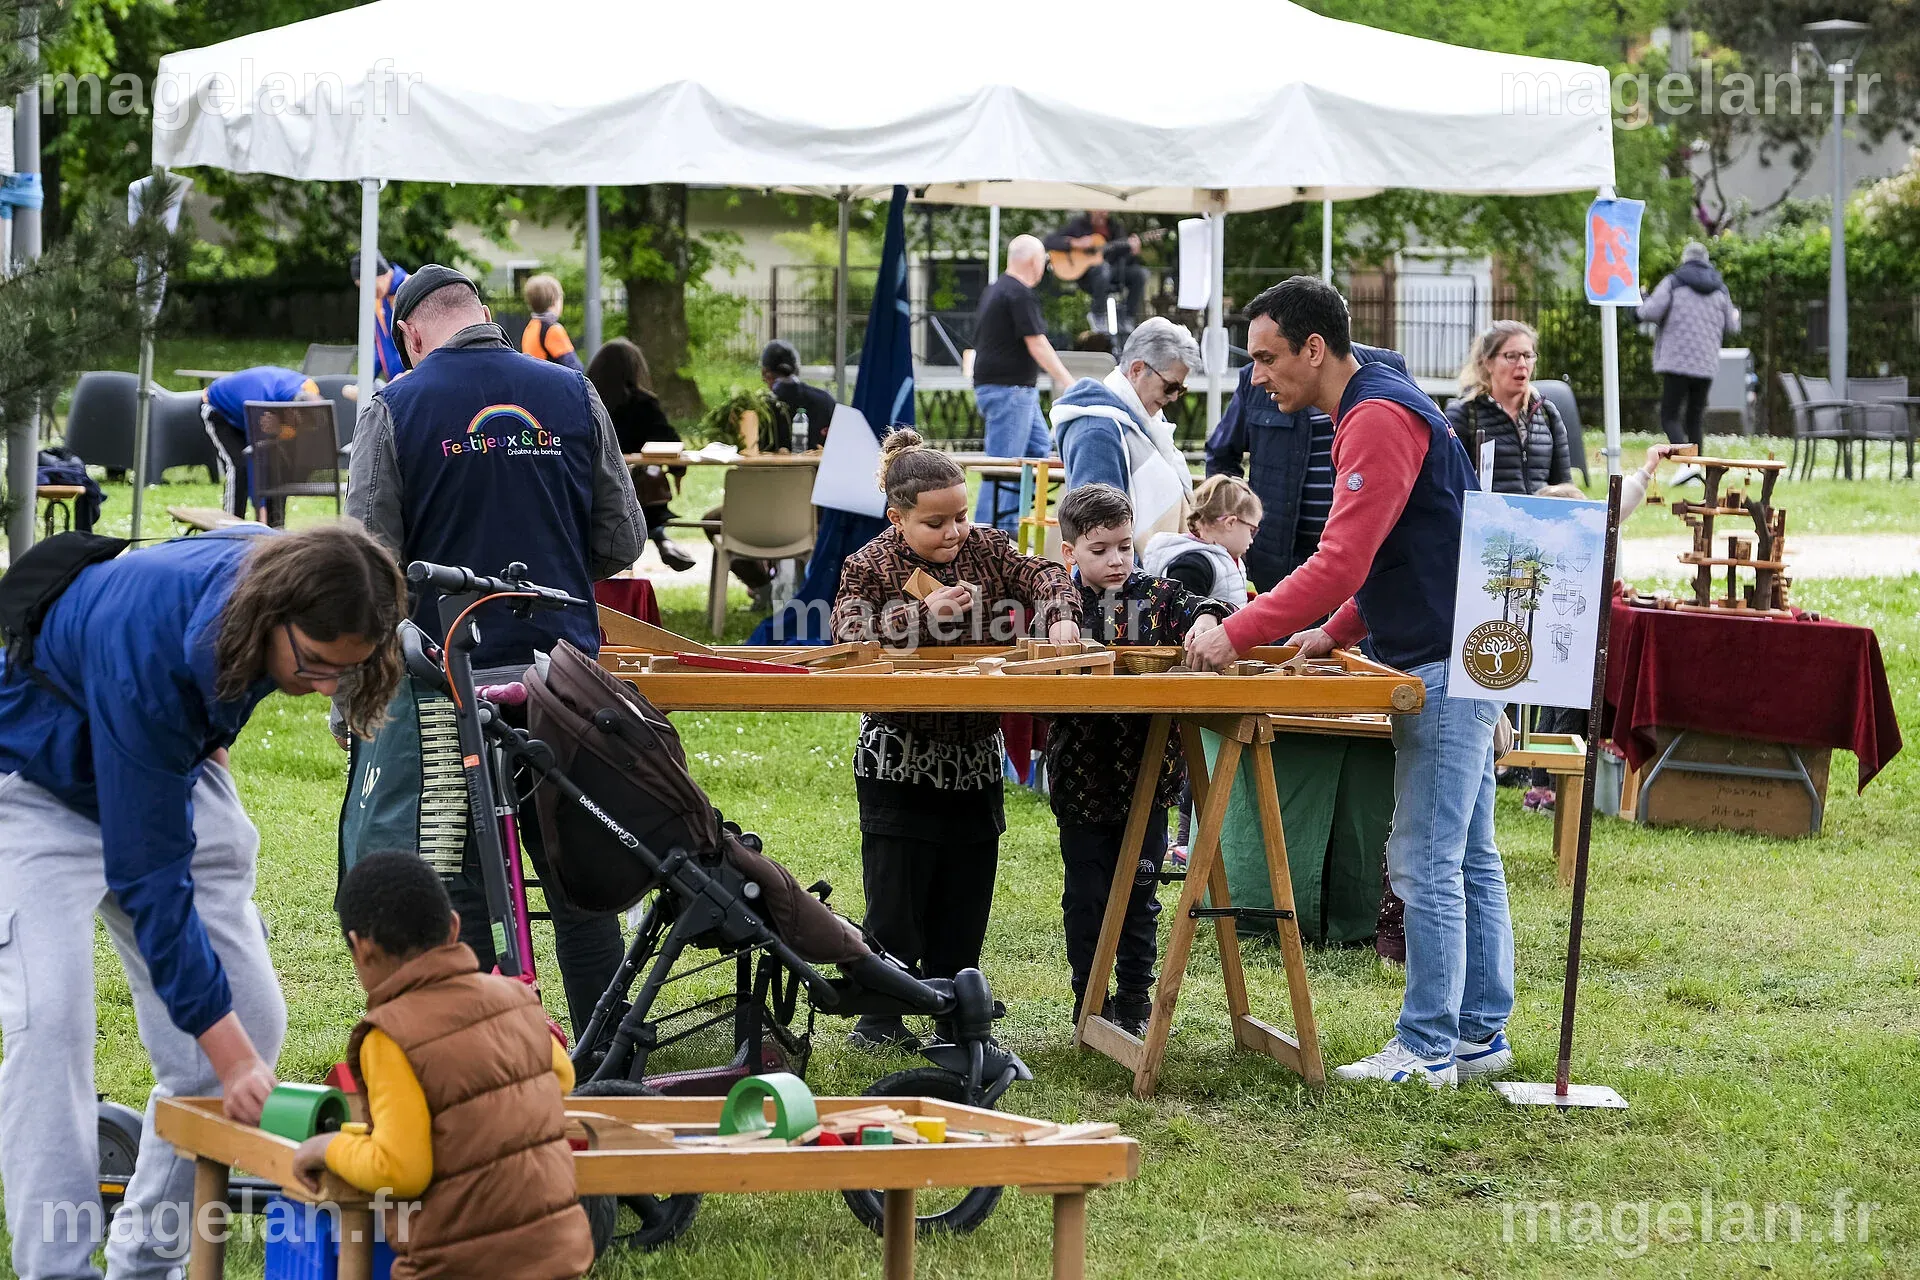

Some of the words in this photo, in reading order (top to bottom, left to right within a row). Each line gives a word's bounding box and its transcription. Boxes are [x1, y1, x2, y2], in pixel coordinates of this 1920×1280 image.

[441, 433, 518, 457] Festijeux
[521, 430, 535, 447] &
[537, 430, 562, 447] Cie
[532, 448, 540, 456] de
[579, 795, 624, 835] bébéconfort
